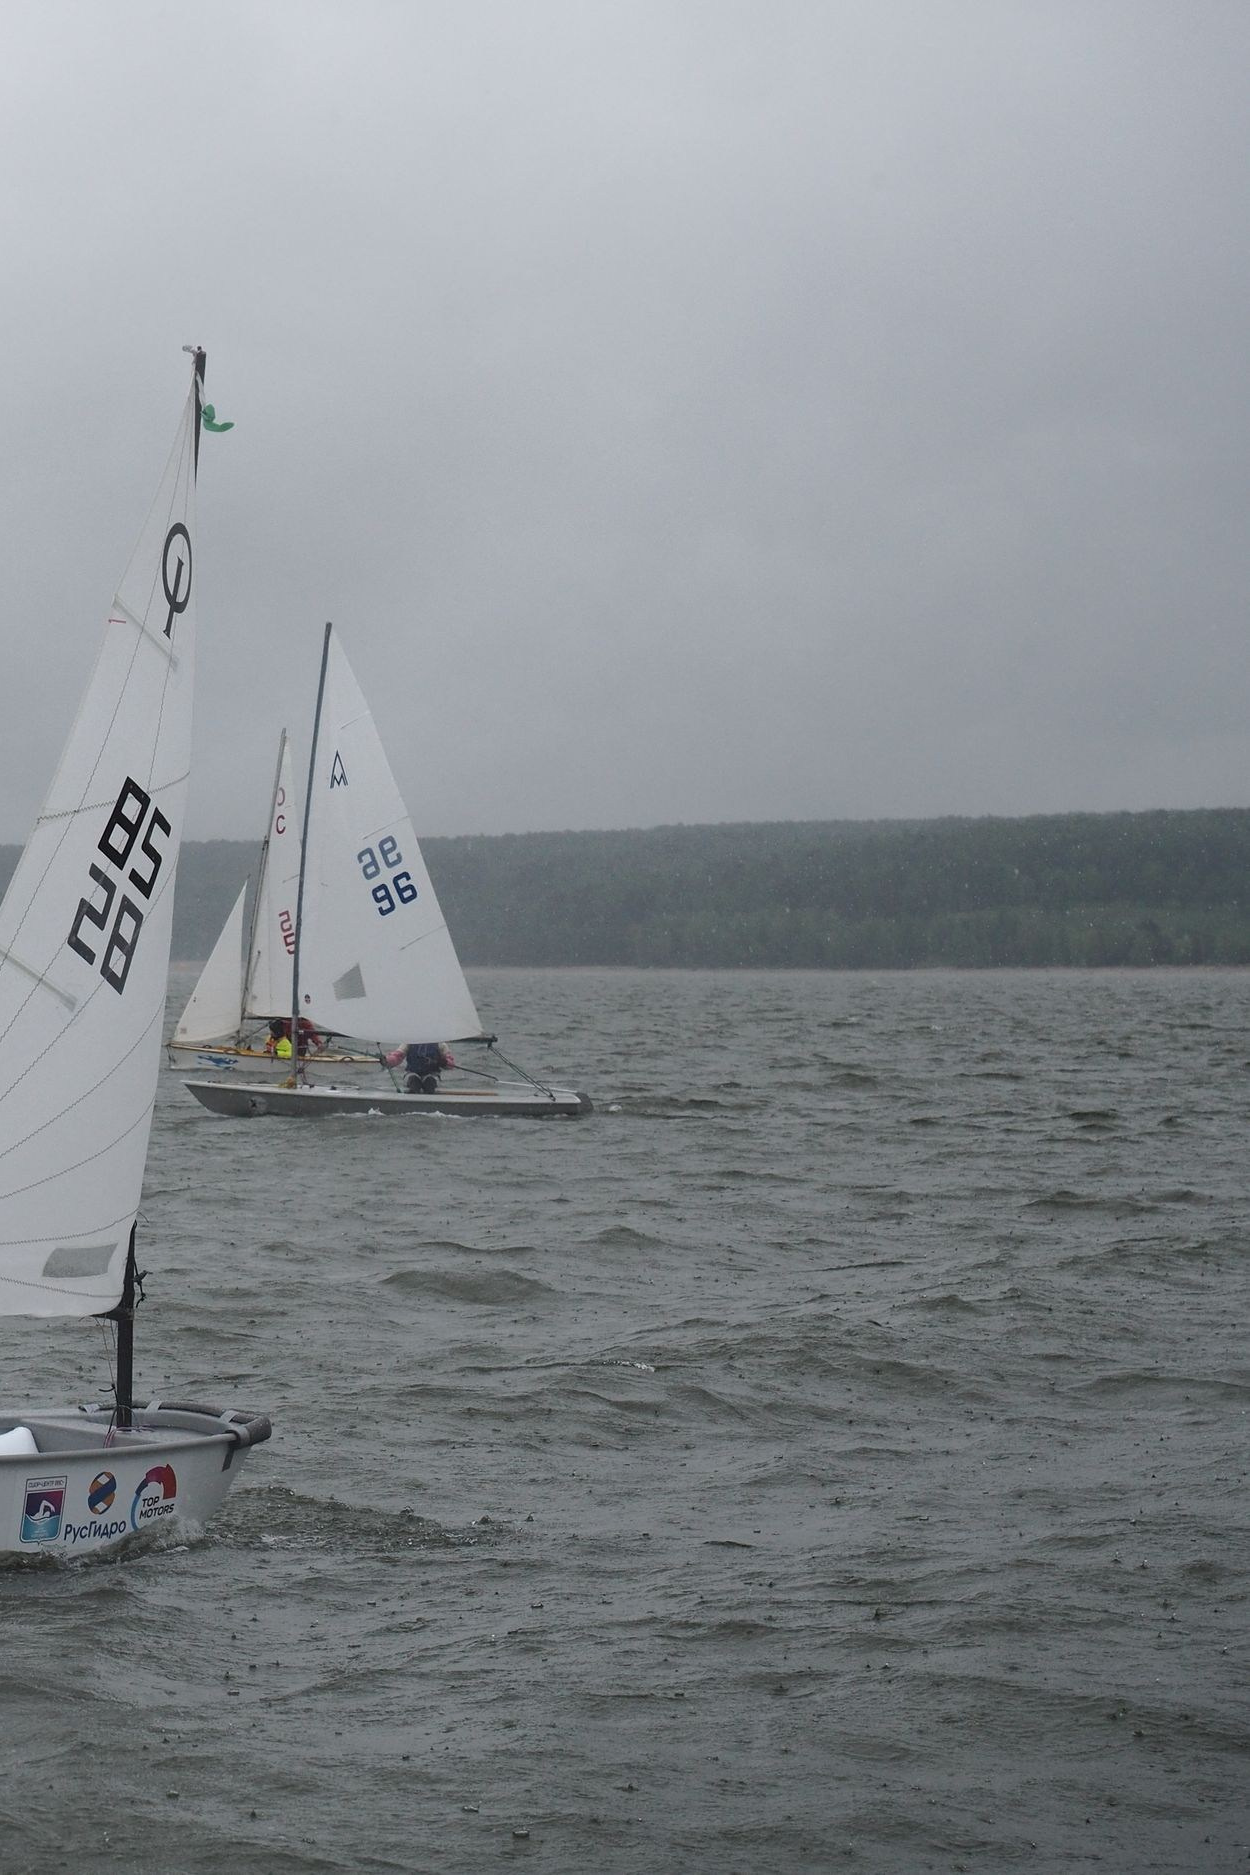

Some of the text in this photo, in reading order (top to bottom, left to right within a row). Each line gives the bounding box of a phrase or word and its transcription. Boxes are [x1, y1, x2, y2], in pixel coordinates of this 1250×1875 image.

[371, 871, 418, 917] 96
[139, 1503, 175, 1520] MOTORS
[142, 1496, 160, 1508] TOP
[64, 1520, 127, 1544] РусГидро
